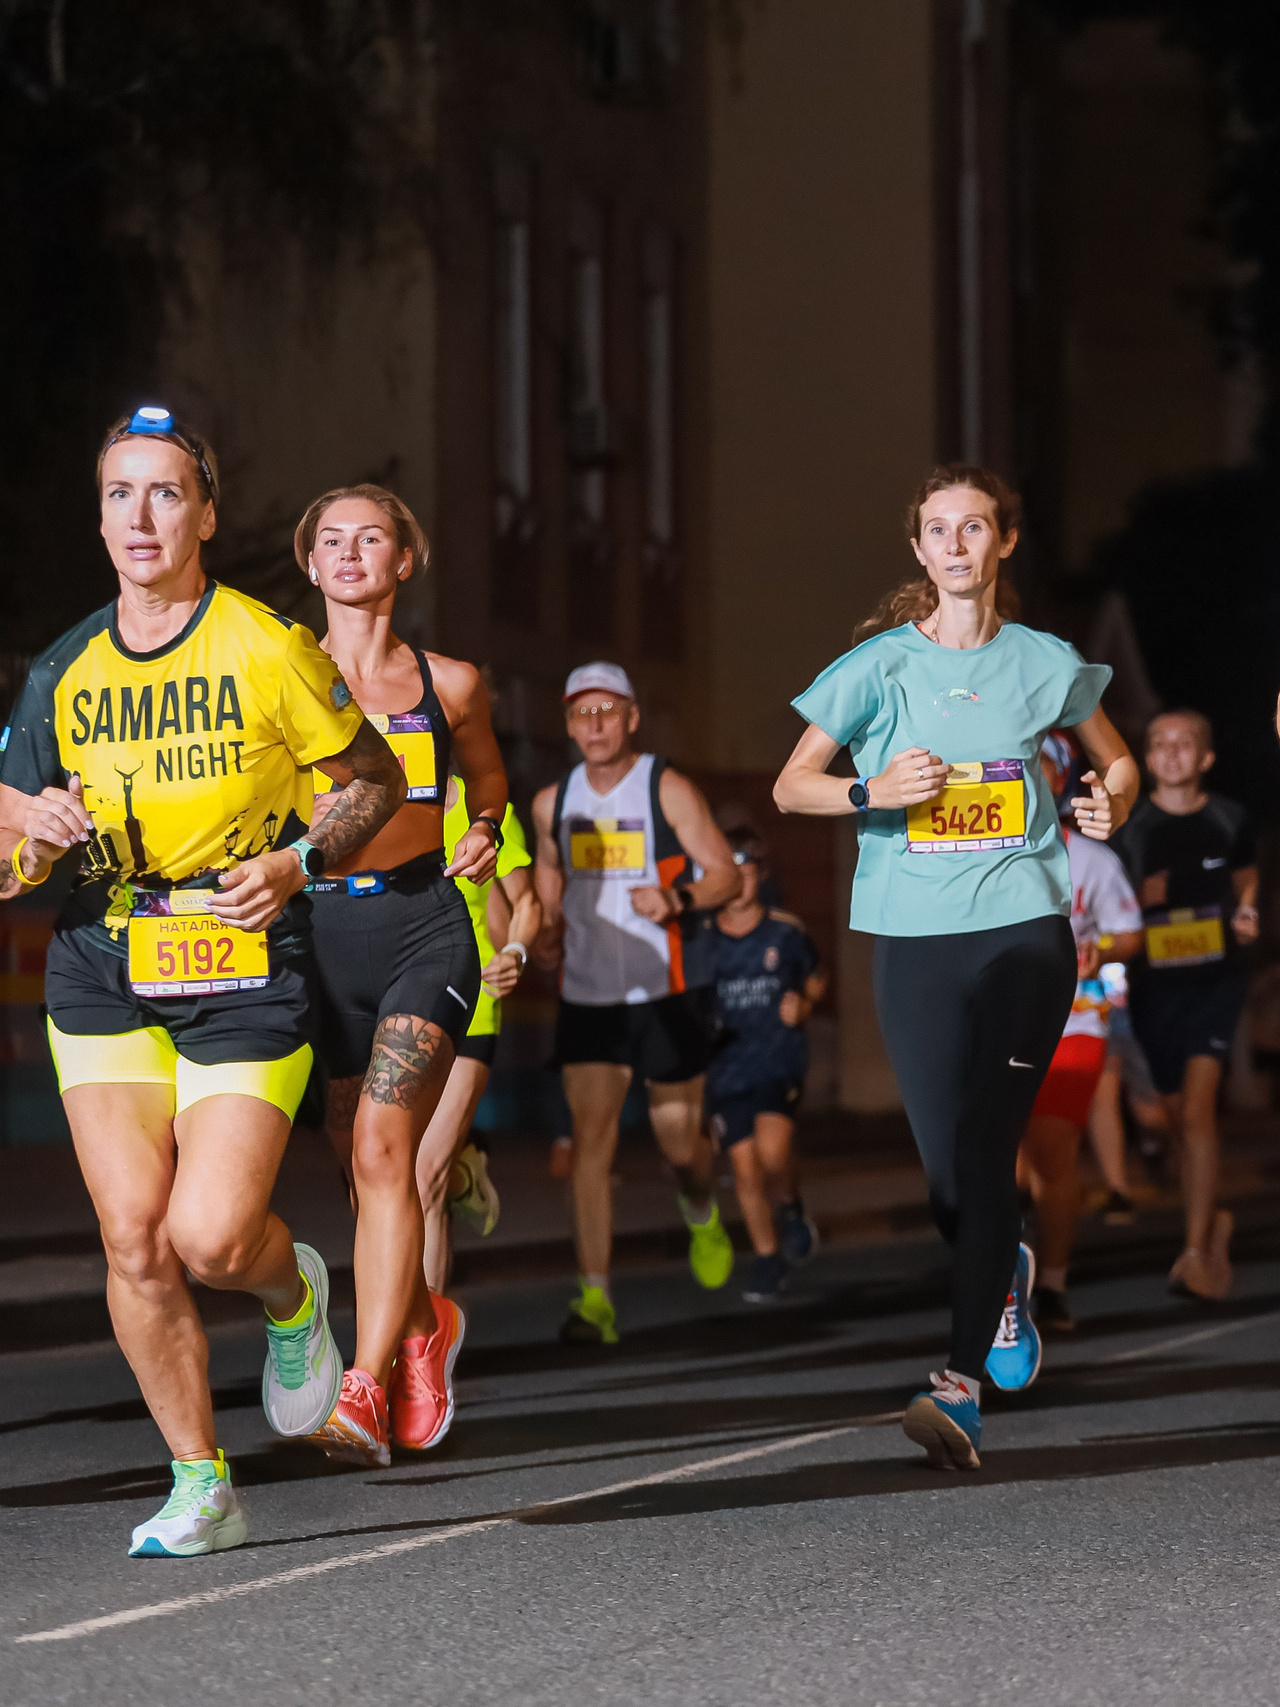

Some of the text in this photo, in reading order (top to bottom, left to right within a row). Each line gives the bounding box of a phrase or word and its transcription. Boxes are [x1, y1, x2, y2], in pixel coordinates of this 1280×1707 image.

[72, 675, 244, 746] SAMARA
[156, 741, 245, 783] NIGHT
[930, 802, 1002, 836] 5426
[157, 937, 236, 977] 5192
